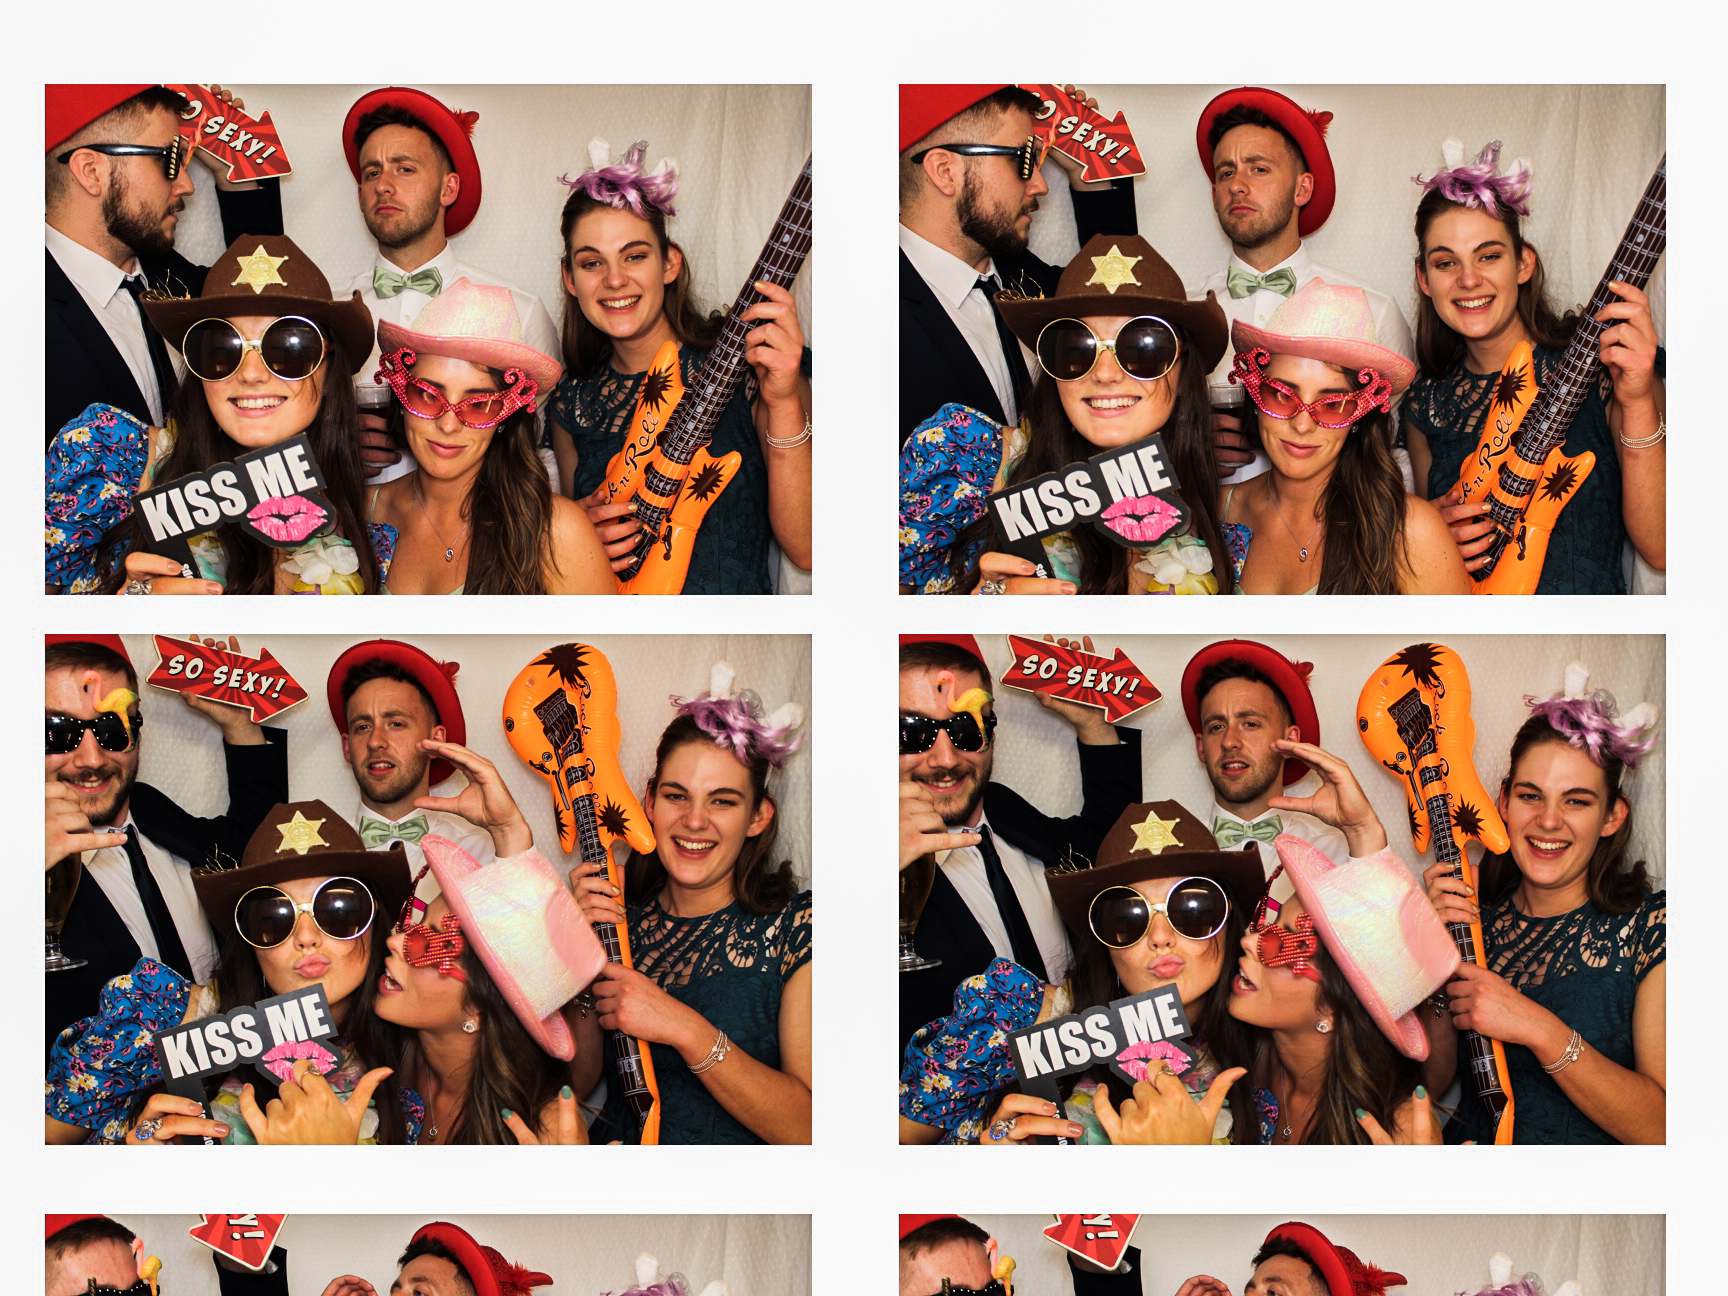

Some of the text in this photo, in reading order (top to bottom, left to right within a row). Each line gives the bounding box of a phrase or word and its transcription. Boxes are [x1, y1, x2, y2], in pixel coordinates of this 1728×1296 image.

[204, 116, 277, 165] SEXY!
[1058, 116, 1131, 165] SEXY!
[139, 444, 318, 542] KISS ME
[993, 444, 1172, 542] KISS ME
[168, 654, 287, 699] SO SEXY!
[1022, 654, 1141, 699] SO SEXY!
[161, 993, 331, 1080] KISS ME
[1015, 993, 1185, 1080] KISS ME
